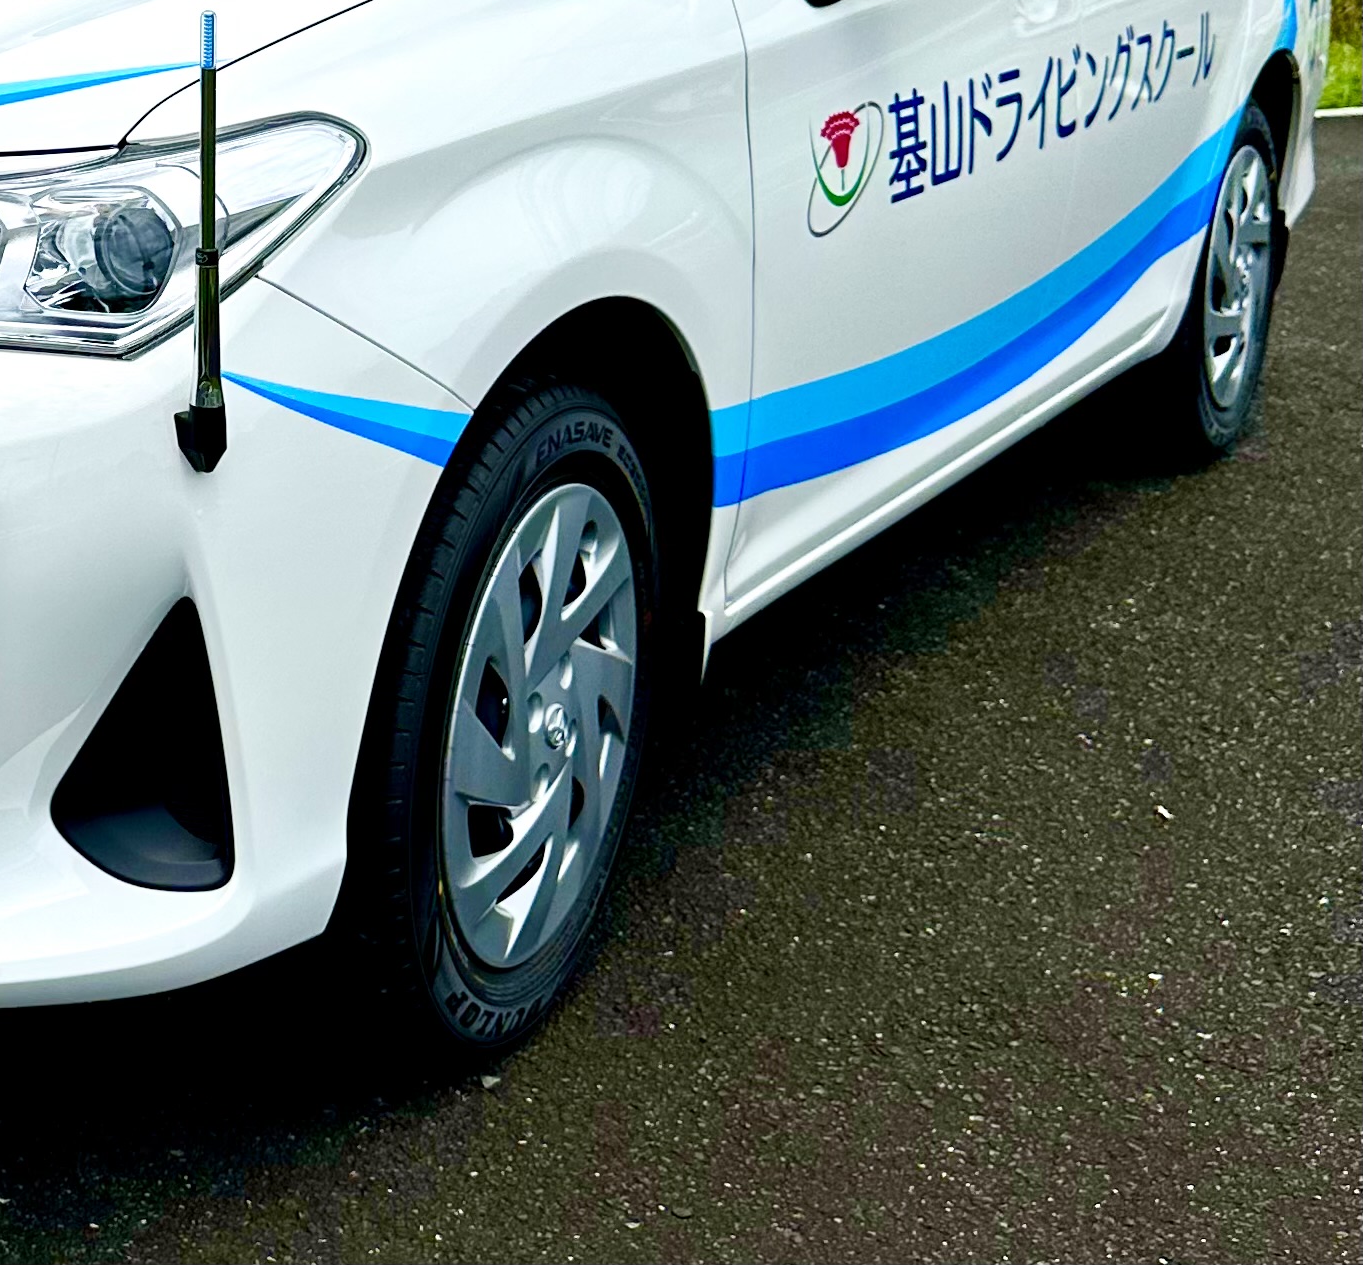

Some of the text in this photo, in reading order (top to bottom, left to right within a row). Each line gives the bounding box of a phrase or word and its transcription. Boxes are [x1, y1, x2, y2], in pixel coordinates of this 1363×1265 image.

[888, 11, 1215, 204] 基山ドライビングスクール
[538, 421, 614, 465] ENASAVE
[445, 991, 544, 1037] DUNLOP
